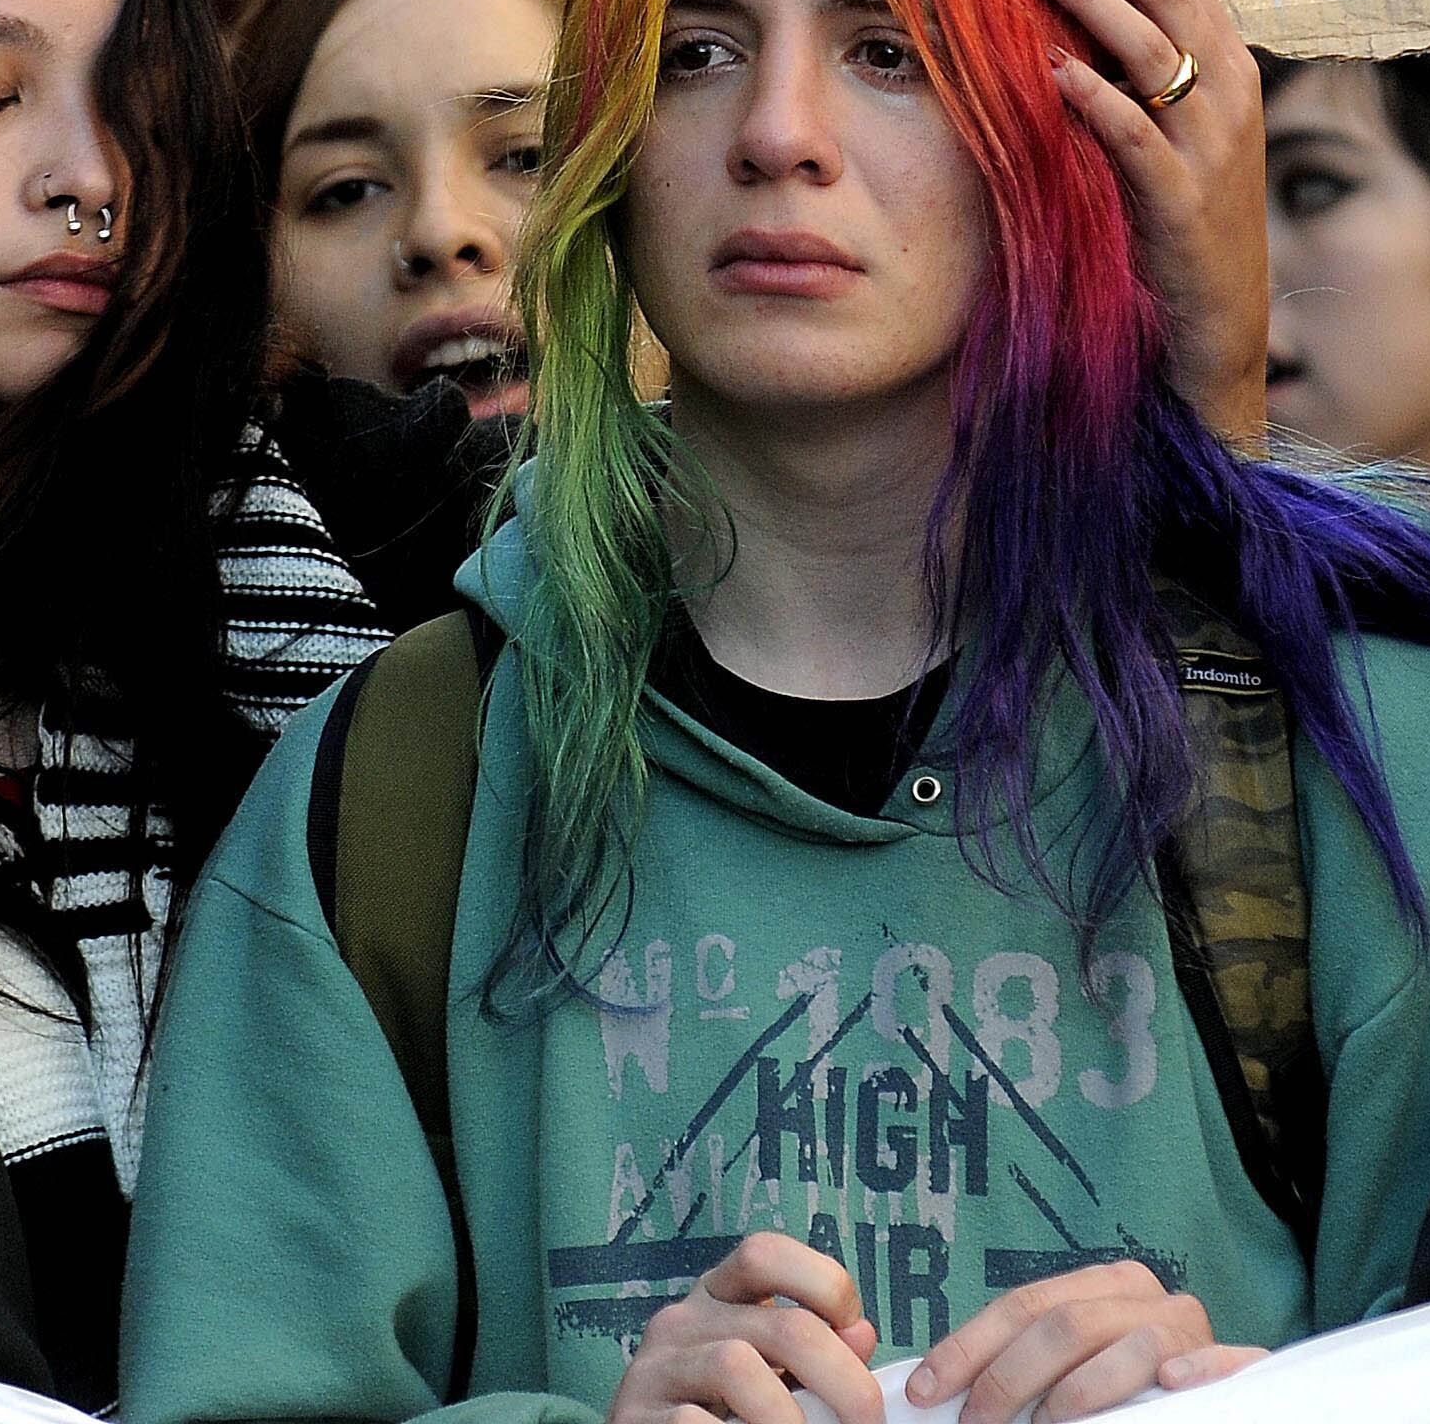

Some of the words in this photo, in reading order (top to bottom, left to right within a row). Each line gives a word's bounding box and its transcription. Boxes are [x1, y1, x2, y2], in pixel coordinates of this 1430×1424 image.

[1186, 667, 1261, 686] Indomito
[777, 942, 1160, 1109] 1983
[756, 1056, 989, 1197] HIGH
